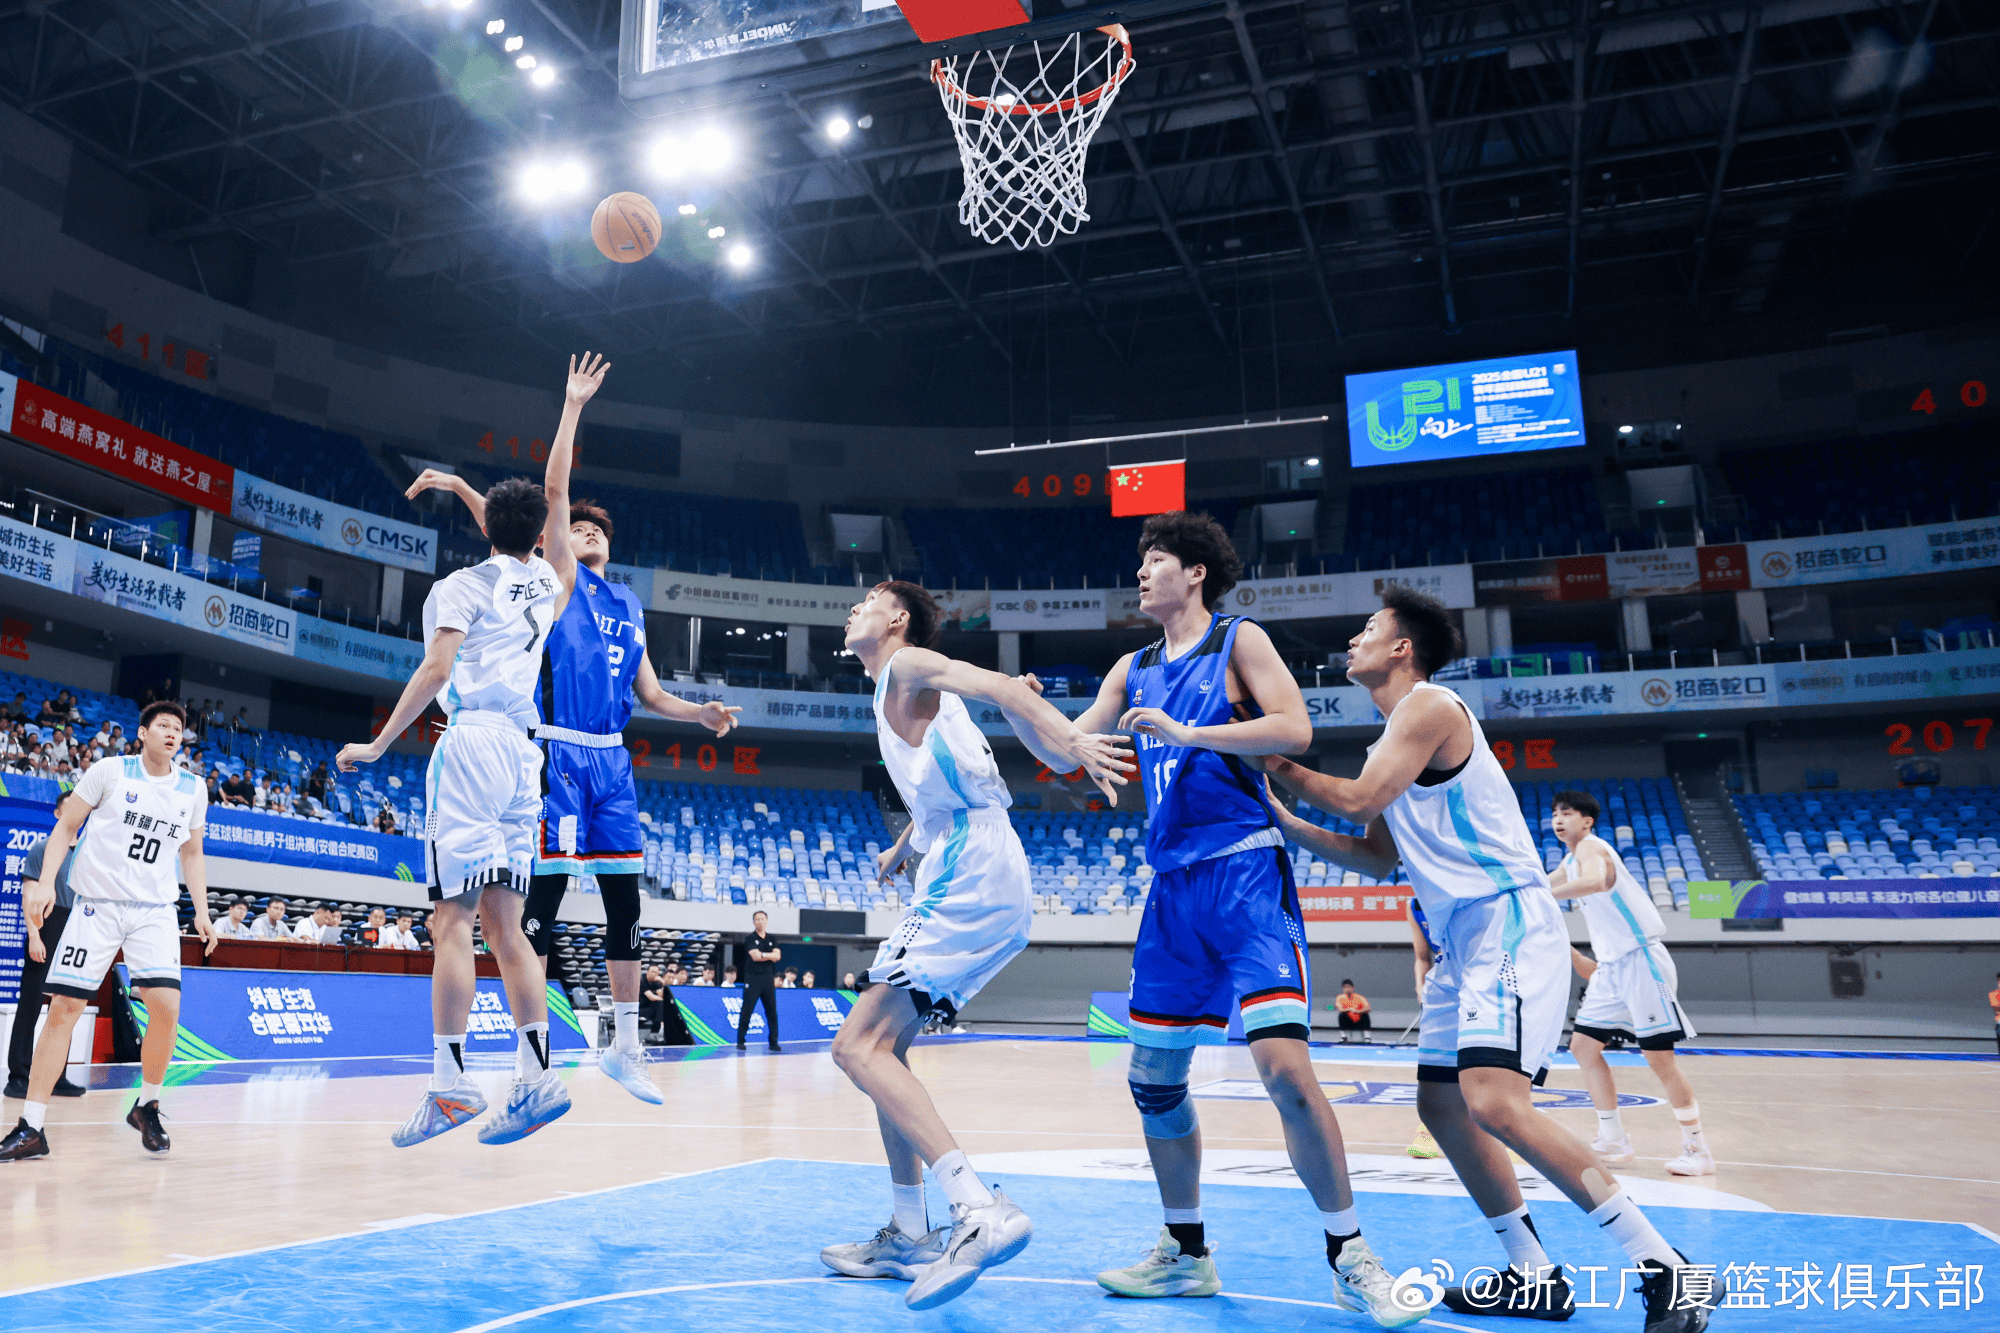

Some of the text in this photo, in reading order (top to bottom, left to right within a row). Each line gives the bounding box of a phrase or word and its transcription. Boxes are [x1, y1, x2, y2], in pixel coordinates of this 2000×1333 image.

[106, 322, 210, 380] 411区
[41, 408, 212, 494] 高端燕窝礼 就送燕之屋
[366, 526, 429, 556] CMSK
[1927, 526, 2000, 548] 赋能城市
[1796, 545, 1887, 569] 招商蛇口
[84, 560, 186, 611] 美好生活承载者
[996, 602, 1020, 611] ICBC
[229, 603, 290, 640] 招商蛇口
[1496, 684, 1615, 710] 美好生活承载者
[1675, 676, 1766, 698] 招商蛇口
[767, 701, 849, 719] 精研产品服务
[1885, 717, 1993, 755] 207
[632, 739, 761, 775] 210区
[123, 810, 181, 839] 新疆广汇
[127, 833, 162, 864] 20
[2, 880, 23, 895] 男子
[1299, 896, 1355, 911] 球锦标赛
[61, 945, 88, 968] 20
[246, 986, 316, 1011] 抖音生活
[247, 1011, 333, 1036] 合肥嘉年华
[465, 1012, 517, 1033] 肥嘉年华
